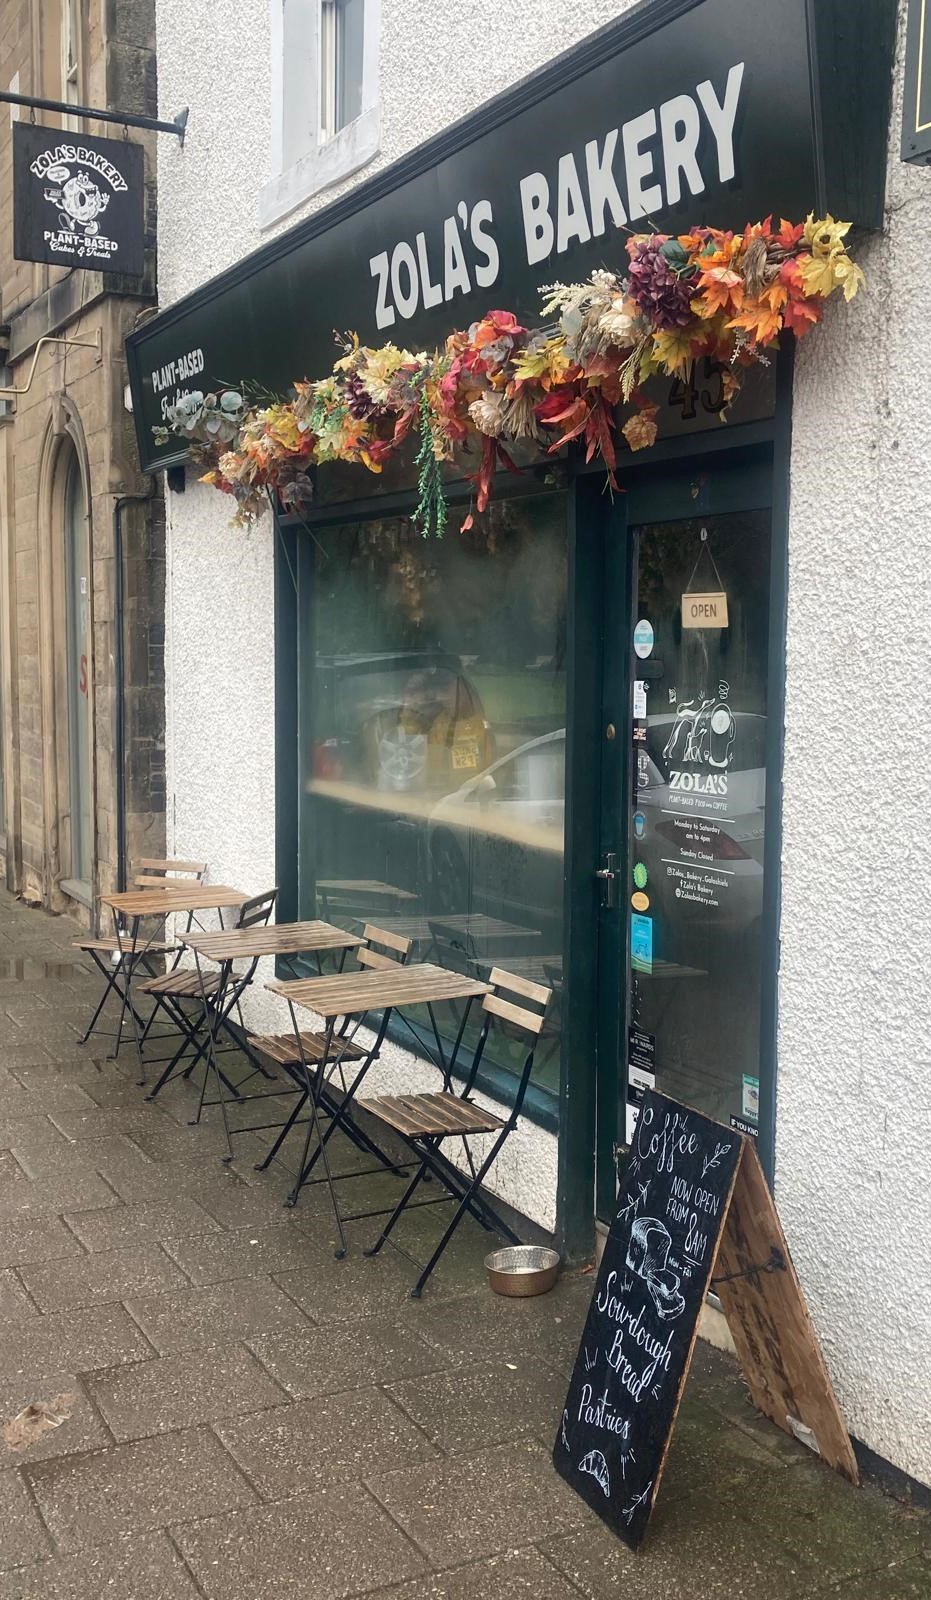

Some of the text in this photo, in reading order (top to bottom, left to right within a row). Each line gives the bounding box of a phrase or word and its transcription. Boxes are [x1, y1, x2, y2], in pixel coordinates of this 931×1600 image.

[30, 144, 128, 191] ZOLA'S BAKERY
[369, 62, 745, 330] ZOLA'S BAKERY
[44, 231, 118, 251] PLANT-BASED
[50, 240, 111, 258] Cakes & Treats
[152, 348, 204, 393] PLANT-BASED
[691, 604, 717, 617] OPEN
[669, 770, 727, 794] ZOLA'S
[674, 819, 692, 830] Monday
[699, 823, 720, 835] Saturday
[680, 847, 713, 861] Sunday Closed
[638, 1105, 698, 1172] Coffee
[666, 1198, 690, 1224] FROM
[671, 1176, 720, 1216] NOW OPEN
[684, 1212, 707, 1260] 8AM
[596, 1271, 675, 1388] Sourdough
[605, 1329, 650, 1403] Bread
[578, 1383, 631, 1440] Pastries
